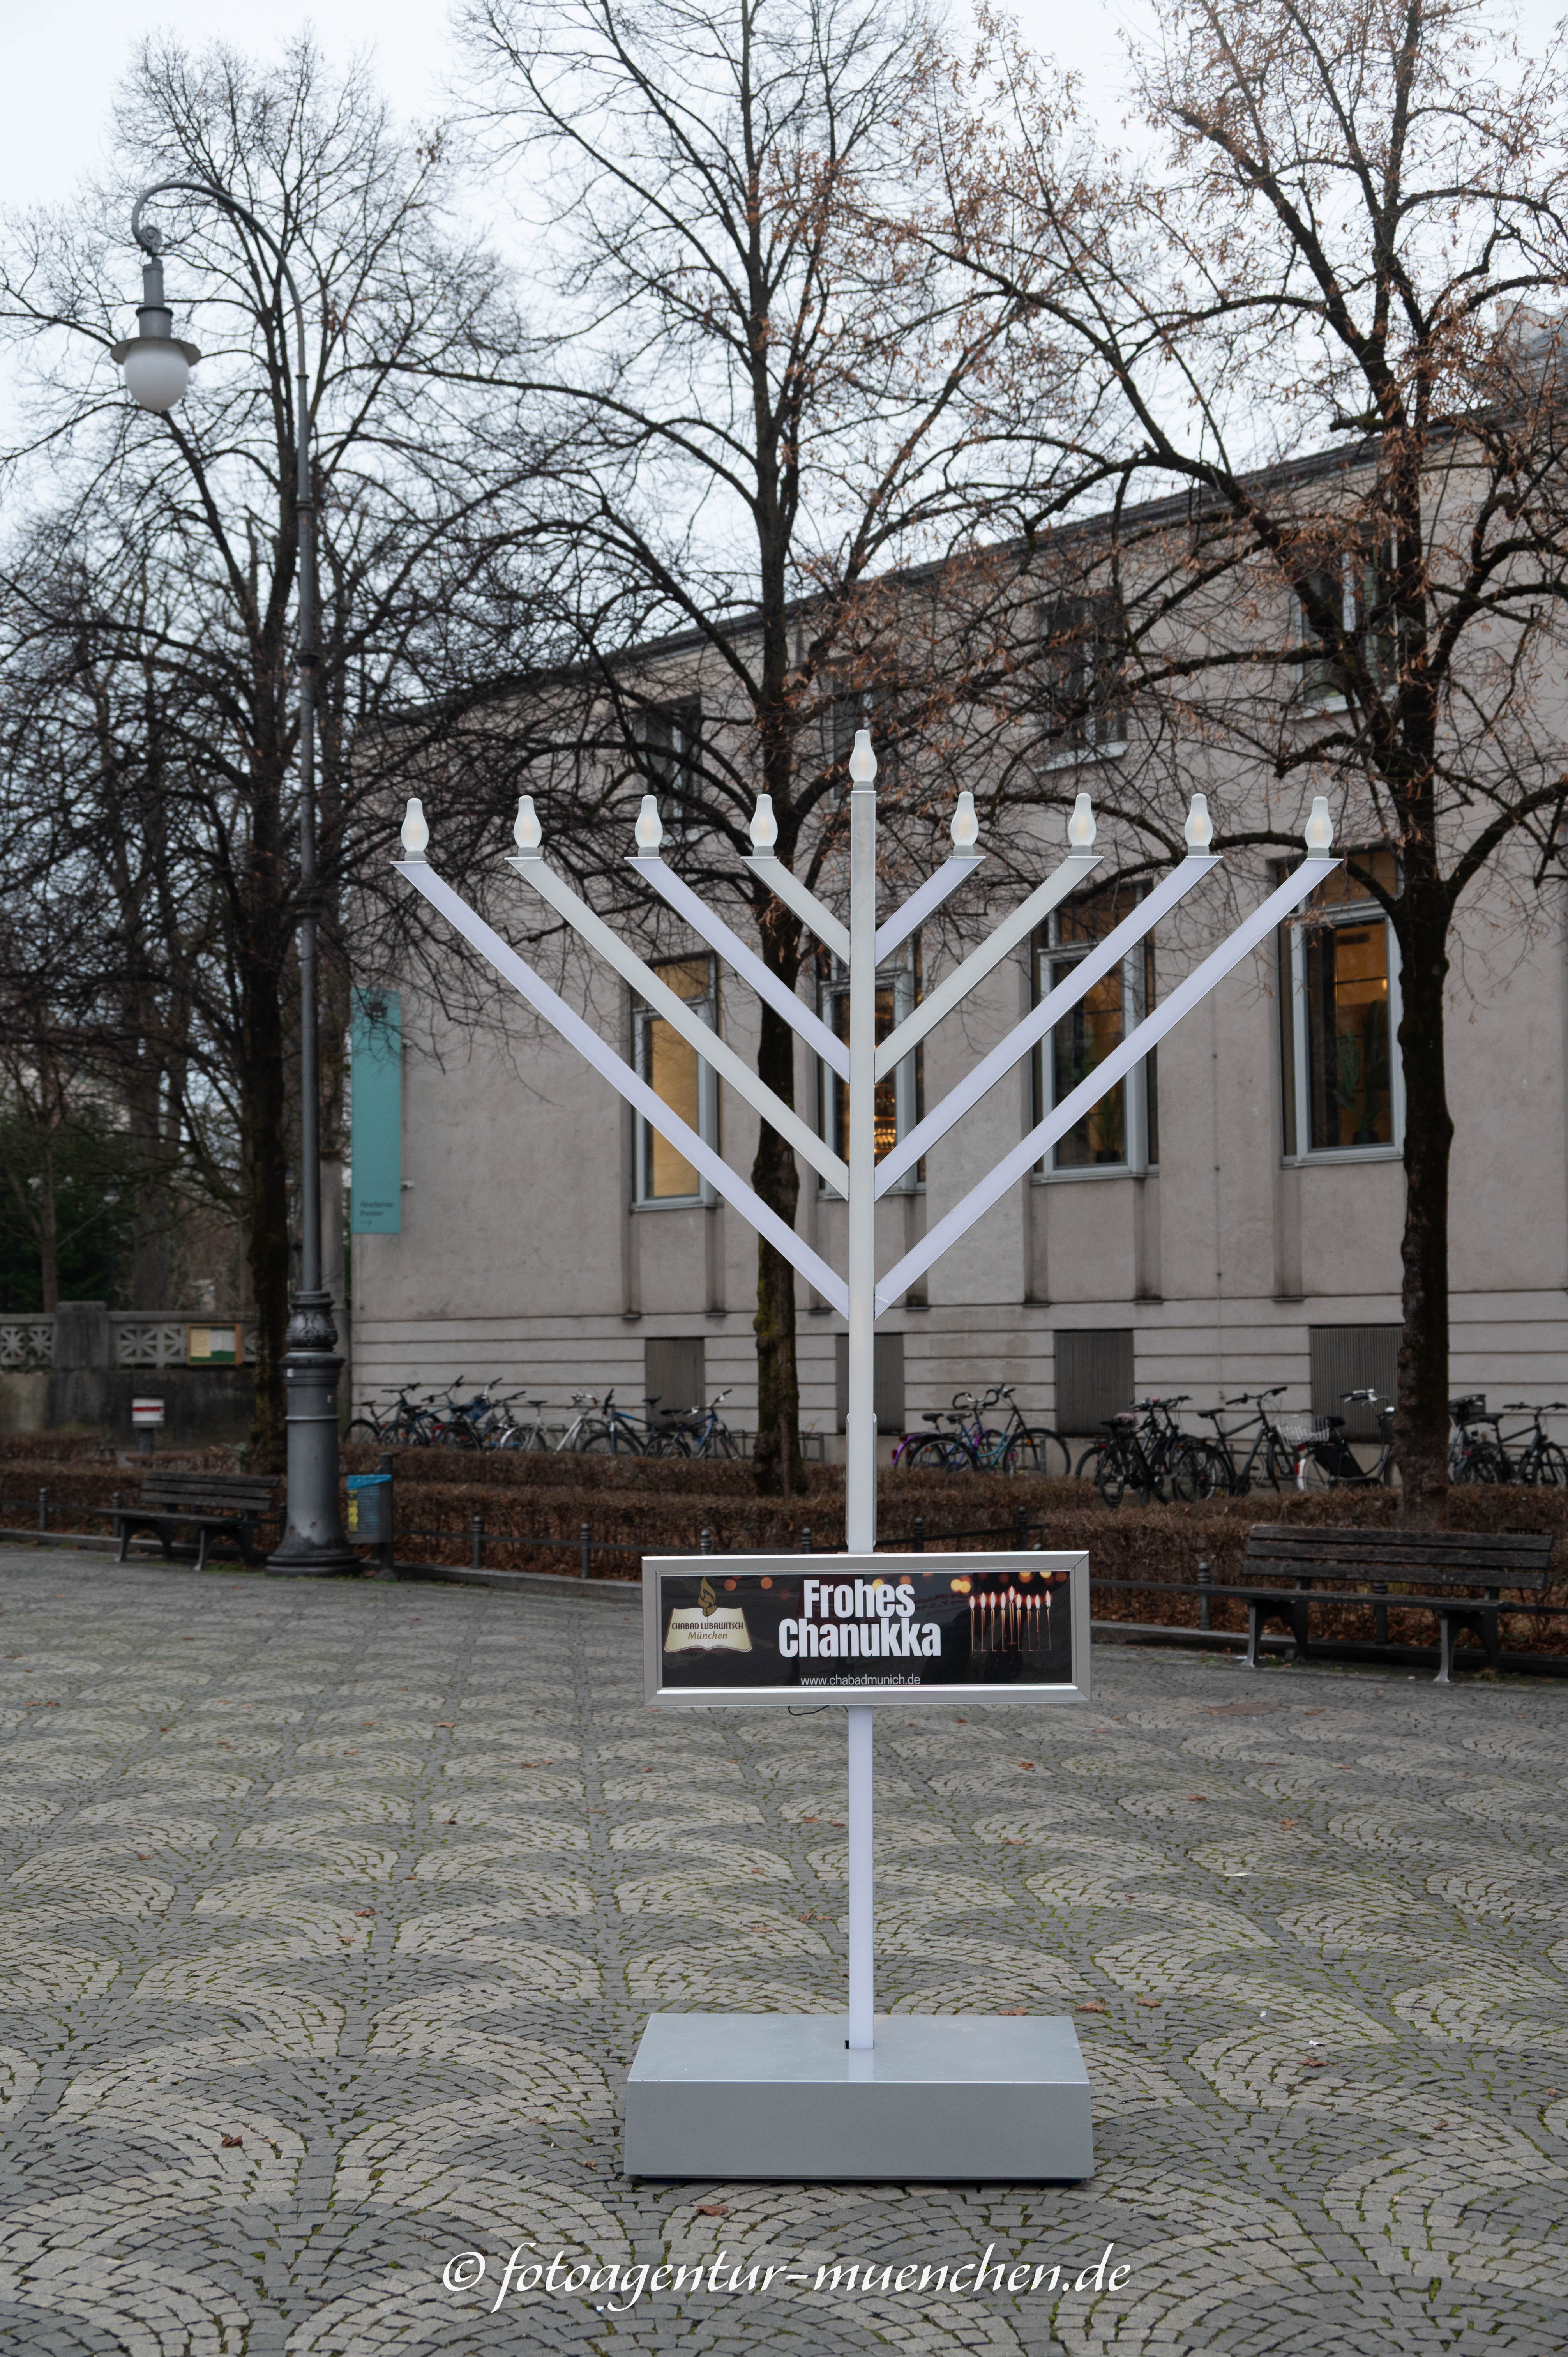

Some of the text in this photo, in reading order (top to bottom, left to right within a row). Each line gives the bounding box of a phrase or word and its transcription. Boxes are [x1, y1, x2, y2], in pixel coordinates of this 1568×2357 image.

[804, 1579, 915, 1618] Frohes
[687, 1631, 728, 1640] München
[779, 1618, 941, 1657] Chanukka
[800, 1673, 921, 1686] www.chabadmunich.de
